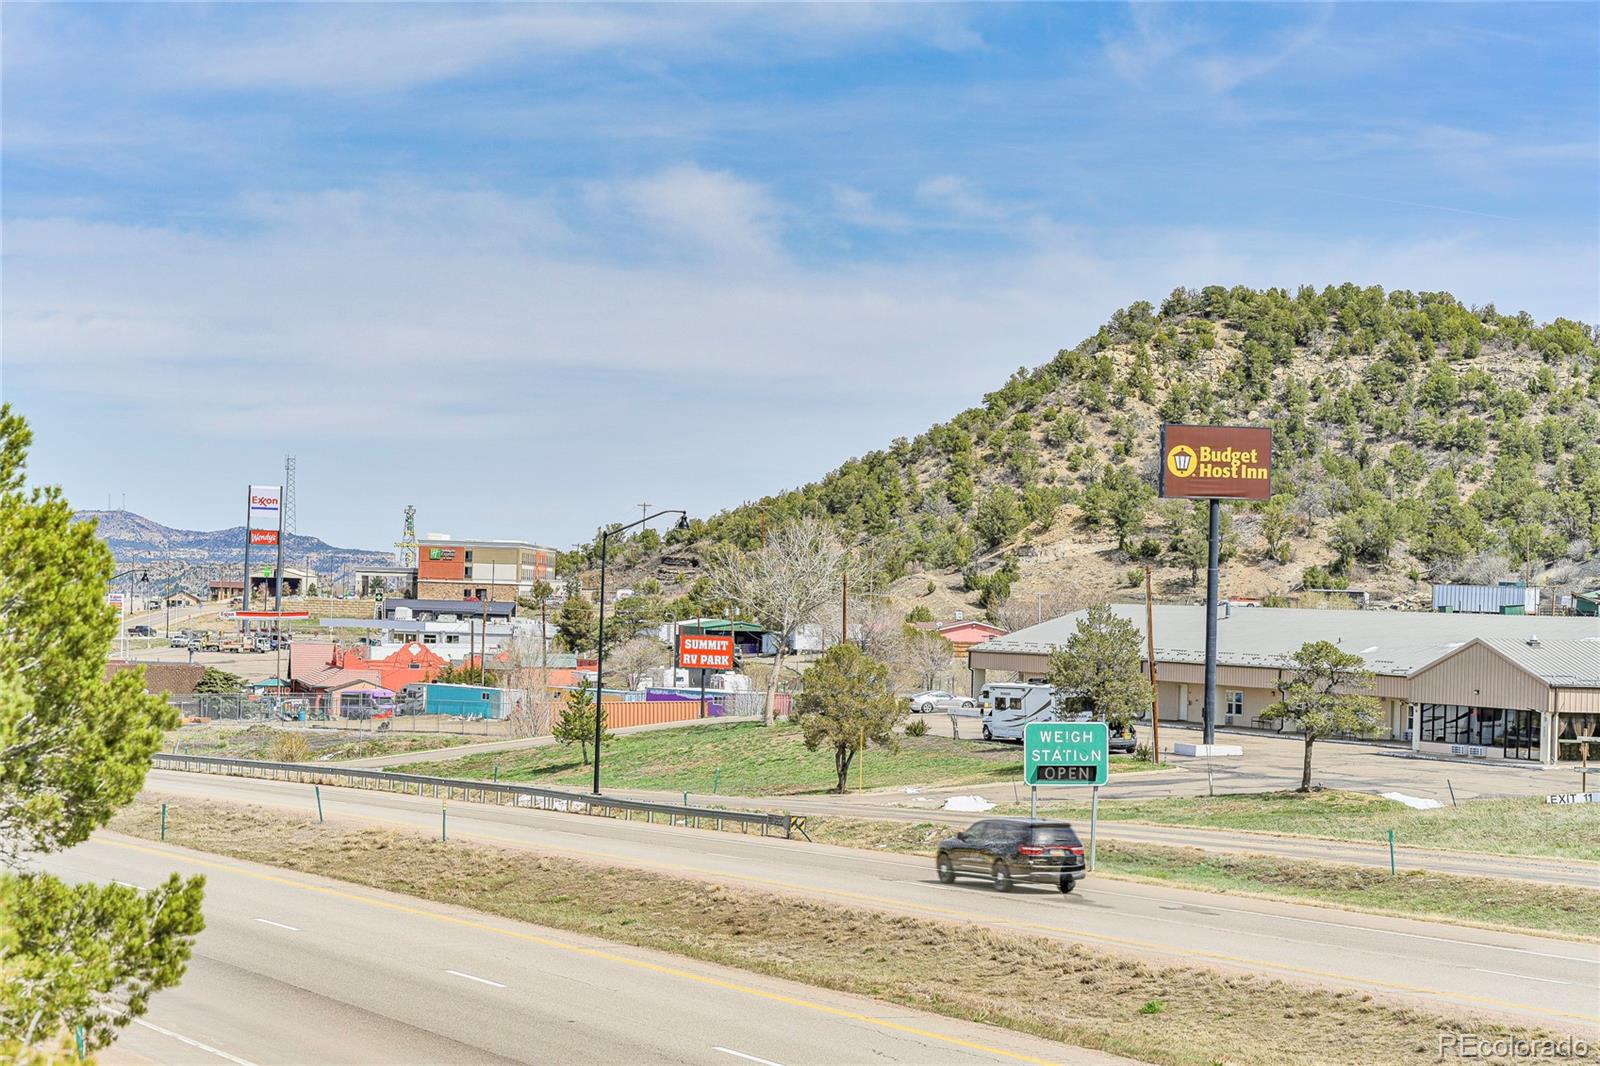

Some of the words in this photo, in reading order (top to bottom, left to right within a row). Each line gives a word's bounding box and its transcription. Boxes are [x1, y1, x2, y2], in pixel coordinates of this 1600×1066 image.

[1200, 447, 1258, 467] Budget
[1200, 463, 1239, 479] Host
[1241, 465, 1268, 479] Inn
[251, 496, 278, 506] Exxon
[685, 639, 729, 651] SUMMIT
[683, 654, 698, 664] RV
[700, 655, 730, 666] PARK
[1040, 731, 1093, 743] WEIGH
[1031, 749, 1102, 762] STATION
[1044, 767, 1089, 780] OPEN
[1550, 794, 1576, 804] EXIT
[1583, 793, 1593, 803] 11
